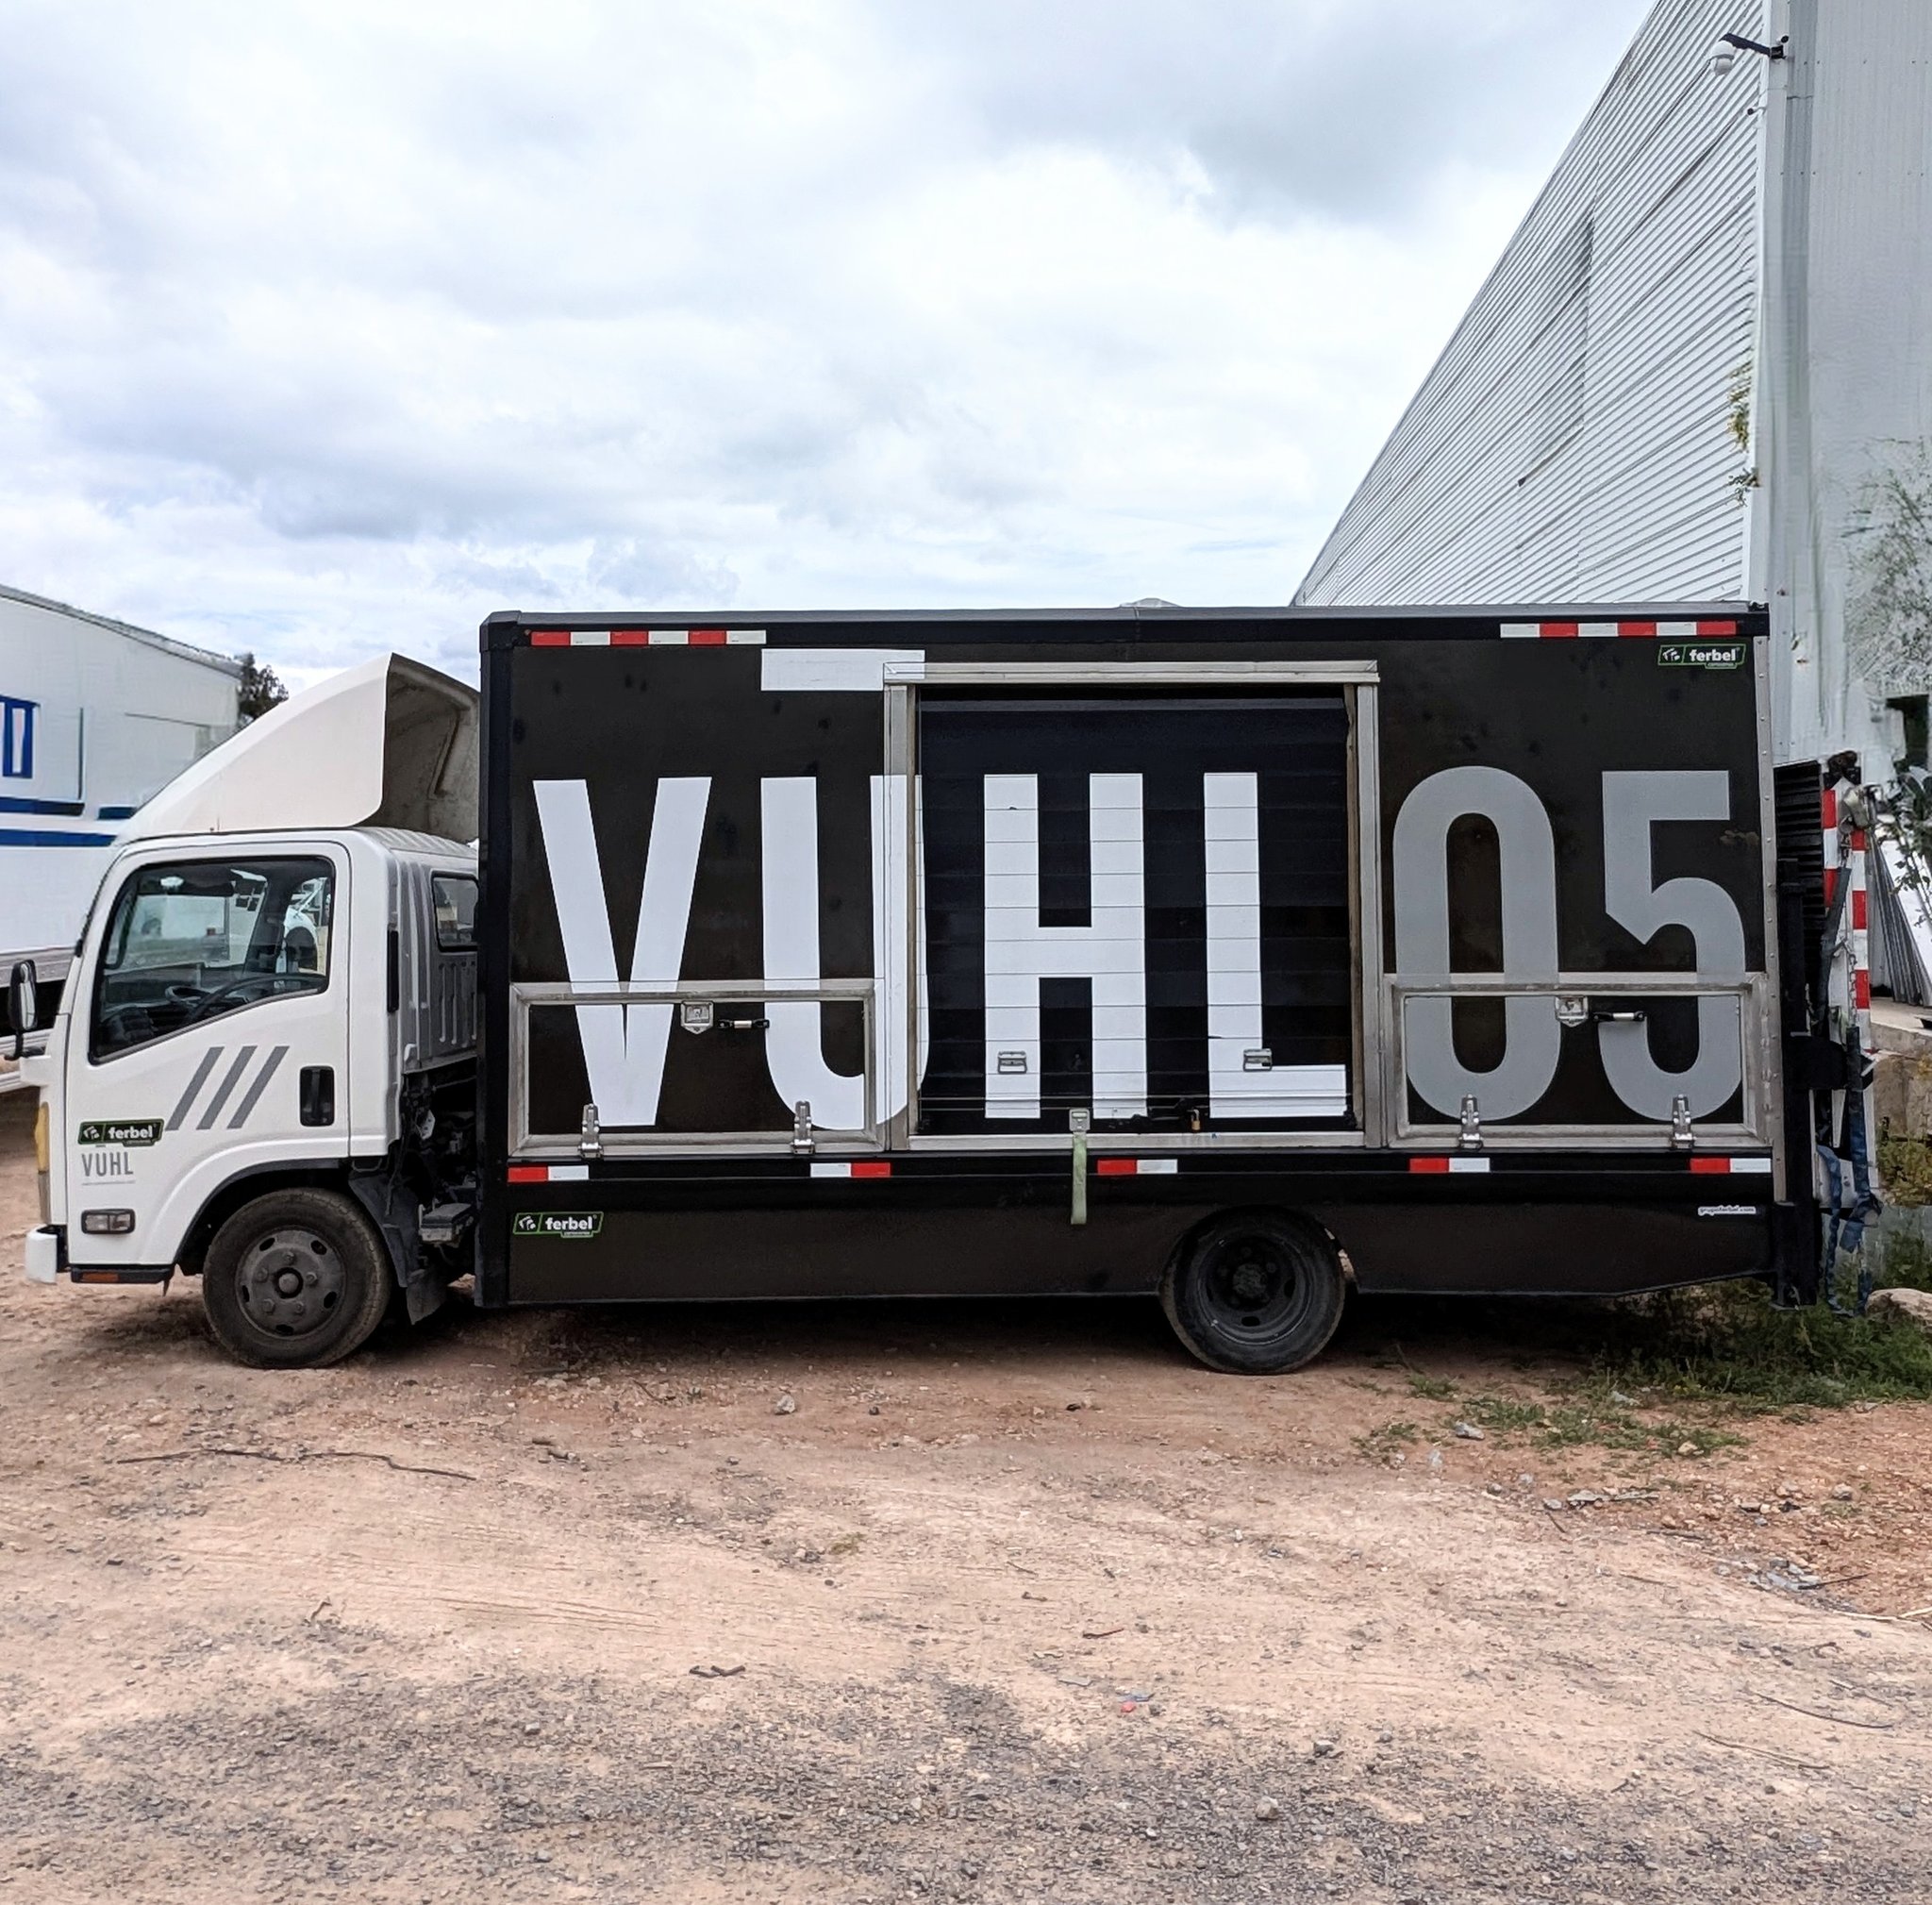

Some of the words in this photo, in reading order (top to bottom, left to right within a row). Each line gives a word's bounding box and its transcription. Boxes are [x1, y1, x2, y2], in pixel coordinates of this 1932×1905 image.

[1690, 648, 1736, 661] ferbel
[108, 1126, 153, 1139] ferbel
[545, 1216, 592, 1229] ferbel
